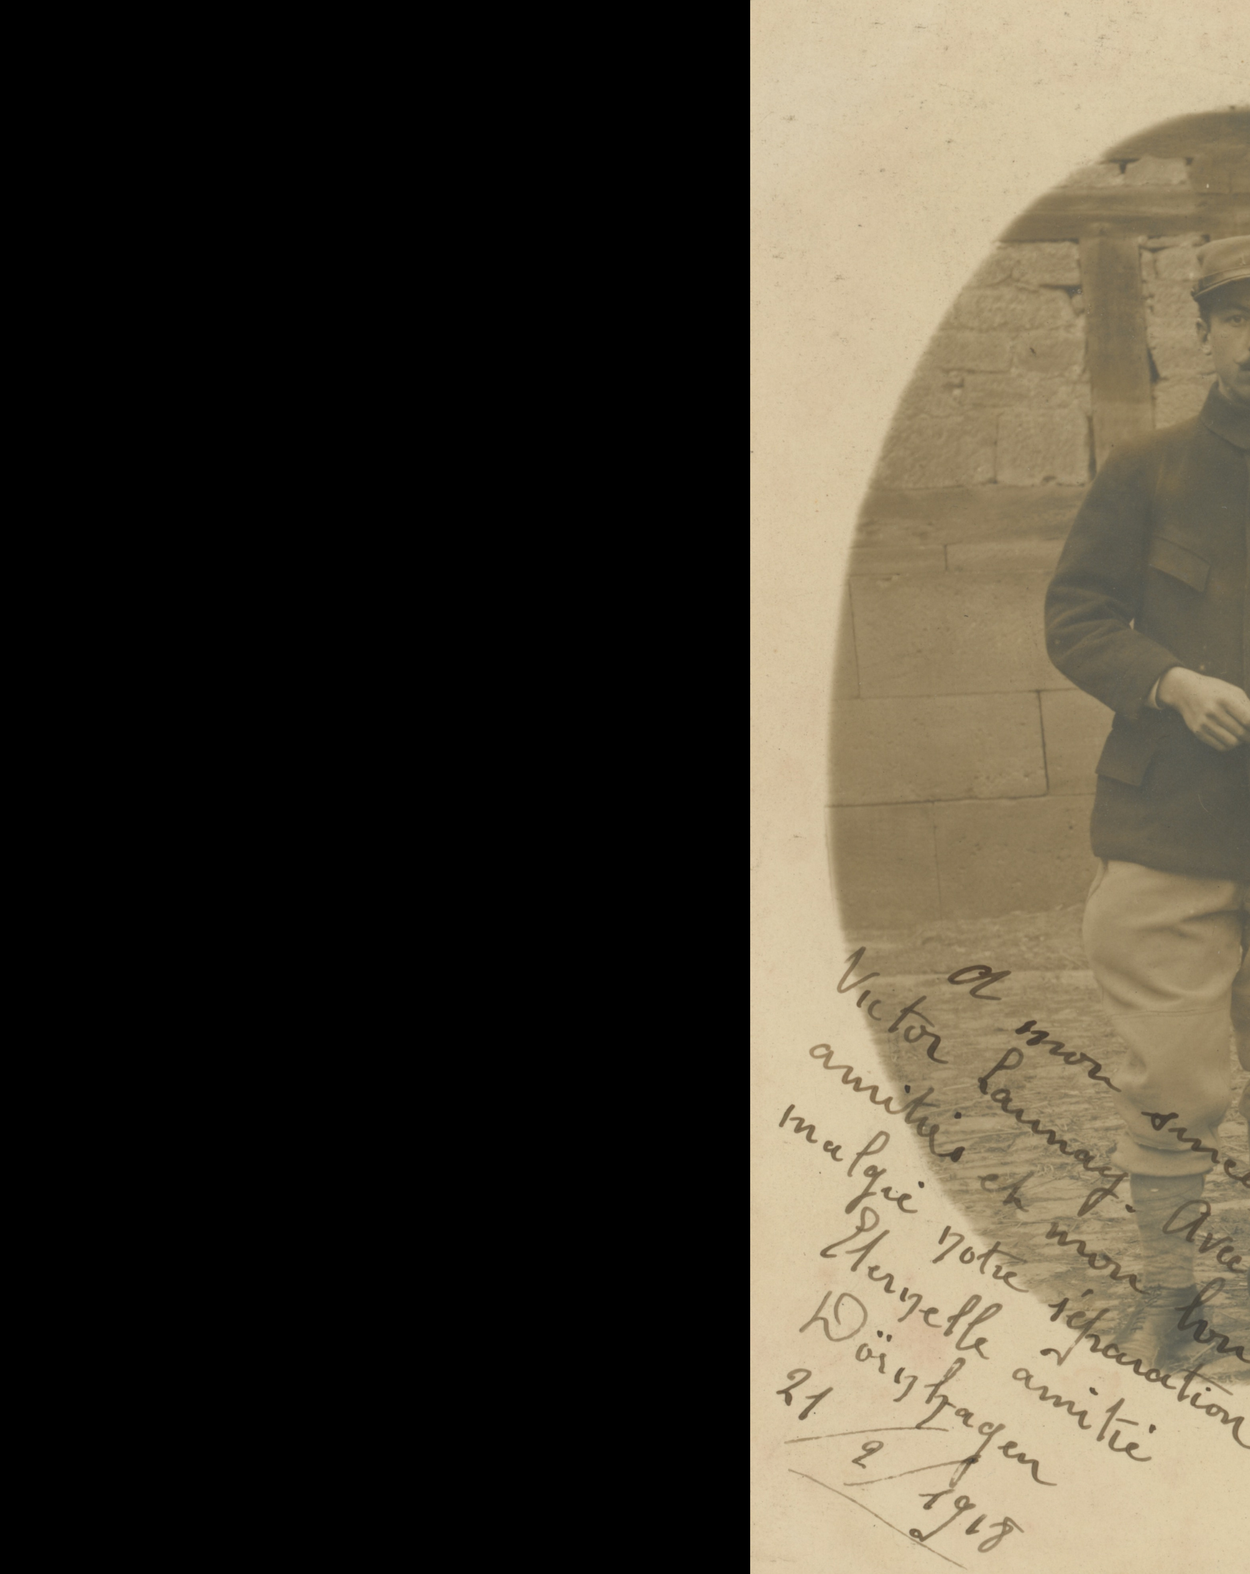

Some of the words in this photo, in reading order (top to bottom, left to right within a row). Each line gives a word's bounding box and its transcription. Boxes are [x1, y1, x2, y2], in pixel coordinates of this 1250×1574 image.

[1015, 1020, 1121, 1092] mon
[836, 946, 949, 1064] Victor
[1162, 1199, 1247, 1274] Avec
[931, 1225, 1030, 1293] notre
[979, 1171, 1034, 1212] et
[1046, 1222, 1150, 1295] mon
